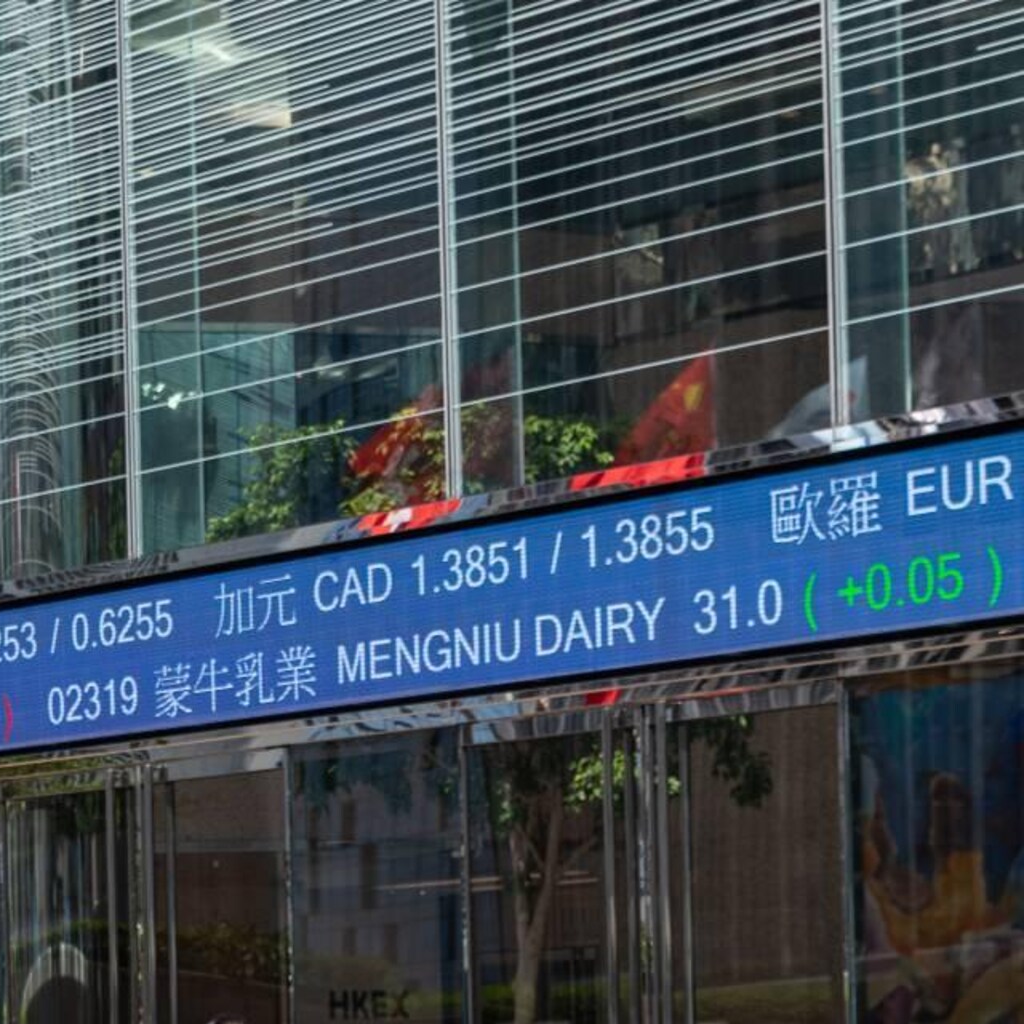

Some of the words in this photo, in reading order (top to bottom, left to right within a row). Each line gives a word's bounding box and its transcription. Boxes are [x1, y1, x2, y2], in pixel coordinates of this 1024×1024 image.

[72, 599, 173, 650] 0.6255
[214, 574, 297, 637] 加元
[314, 563, 392, 611] CAD
[411, 537, 527, 595] 1.3851
[581, 506, 714, 567] 1.3855
[770, 471, 882, 544] 歐羅
[907, 456, 1013, 516] EUR
[48, 676, 138, 725] 02319
[154, 646, 316, 717] 蒙牛乳業
[338, 619, 520, 684] MENGNIU
[535, 597, 665, 656] DAIRY
[694, 580, 782, 634] 31.0
[329, 989, 410, 1019] HKEX
